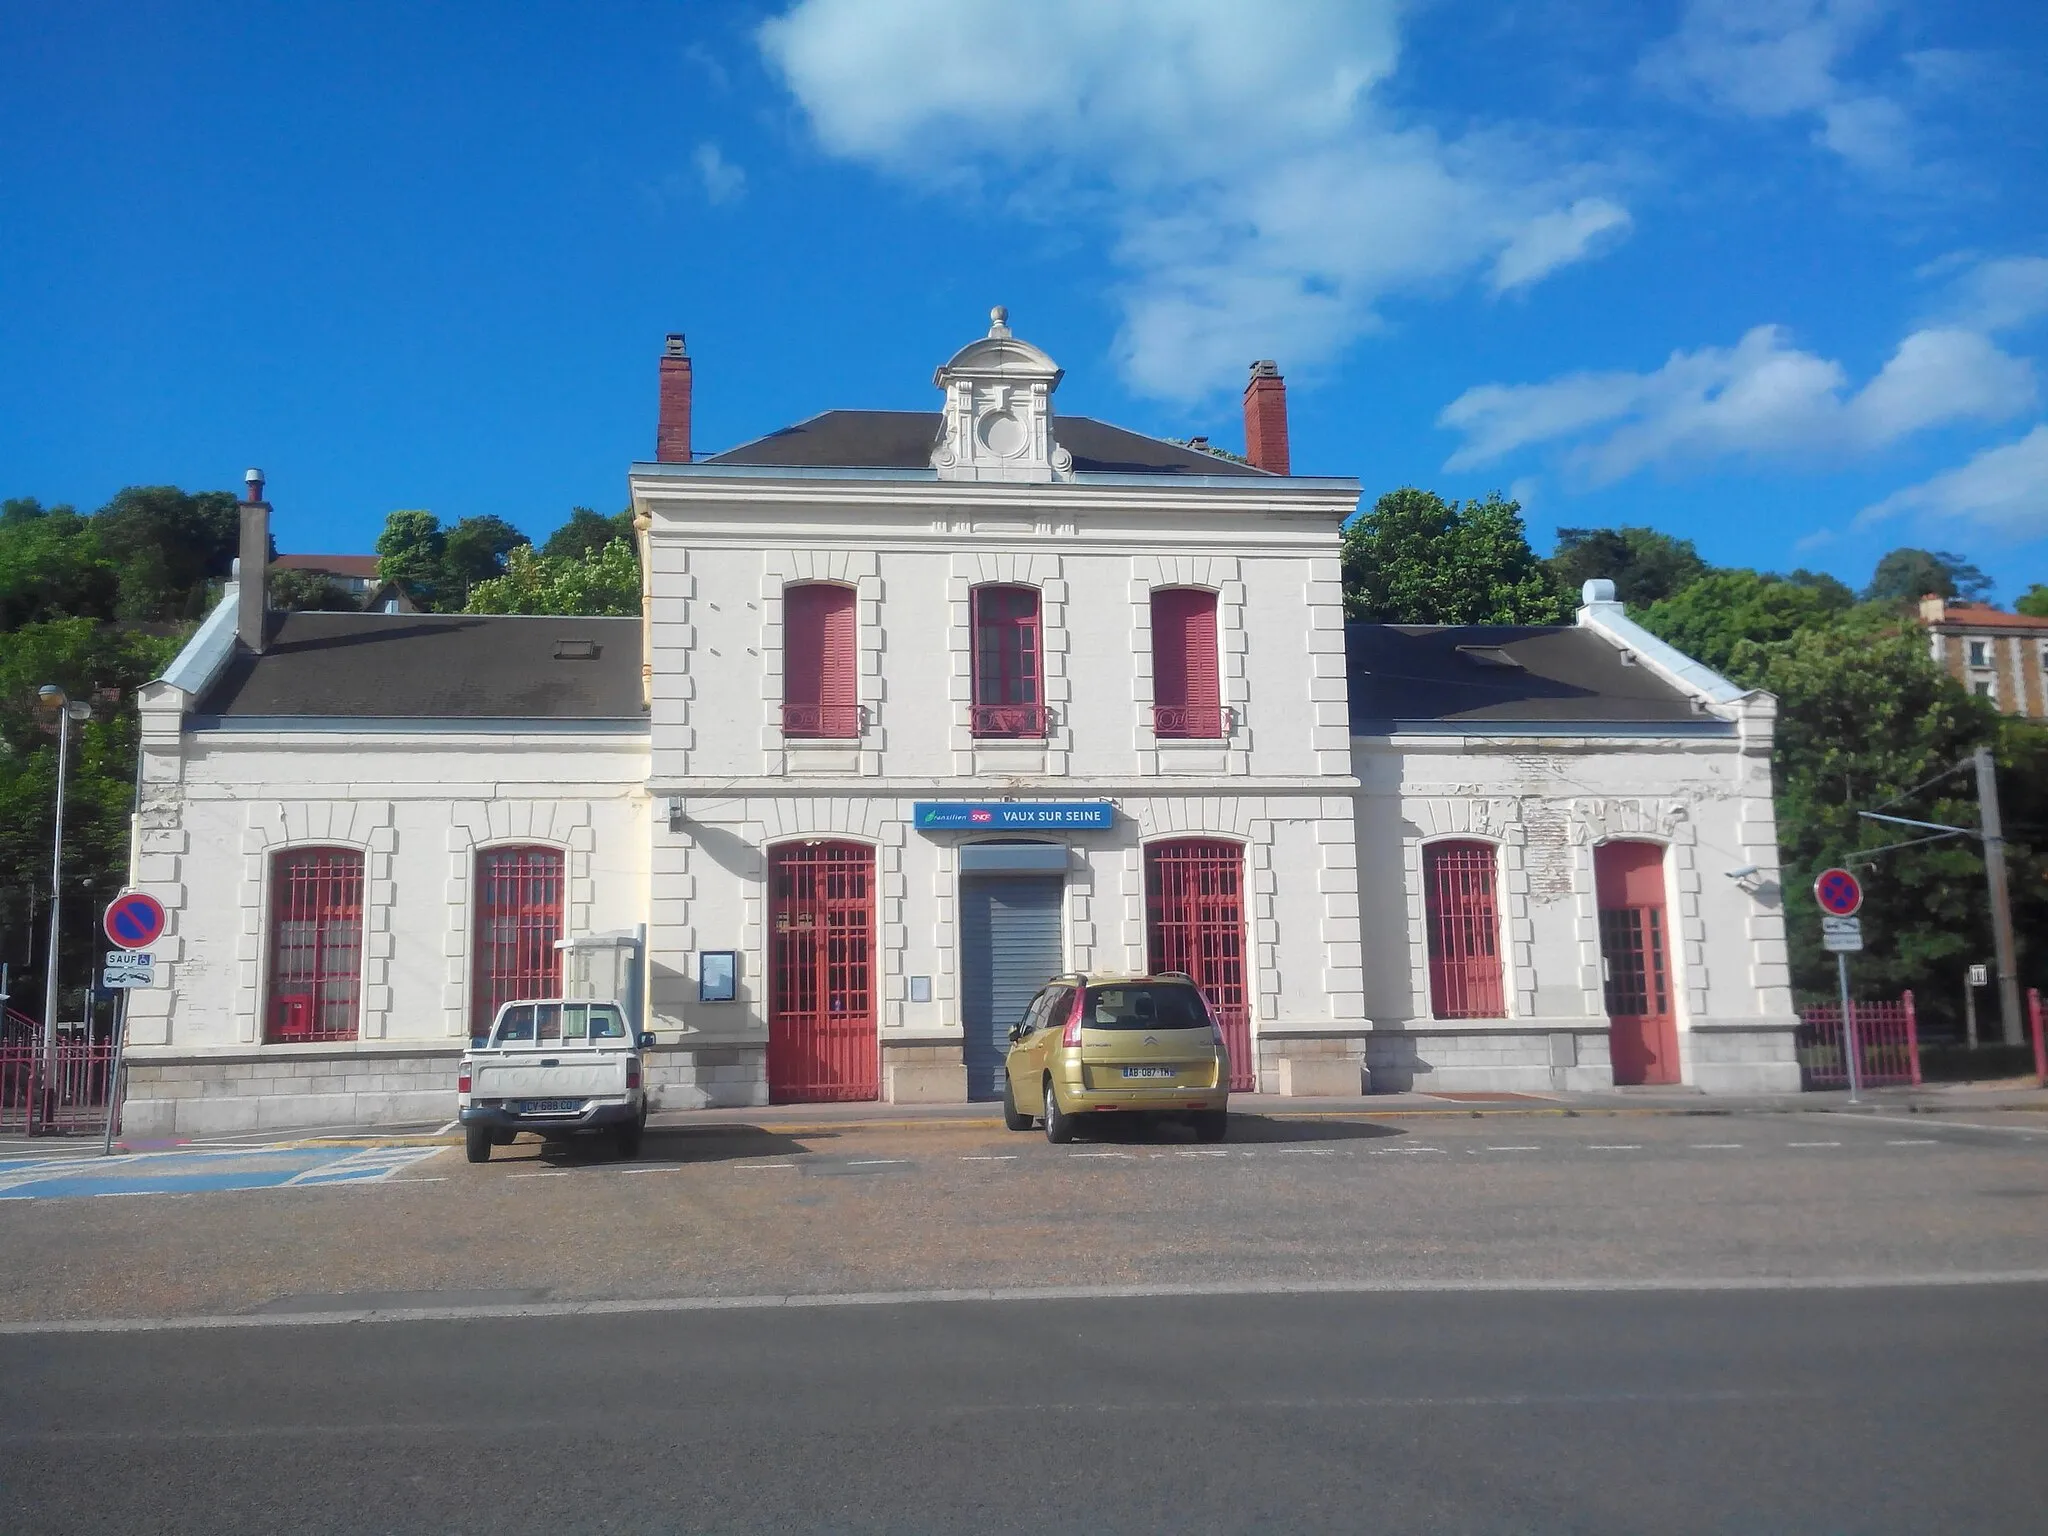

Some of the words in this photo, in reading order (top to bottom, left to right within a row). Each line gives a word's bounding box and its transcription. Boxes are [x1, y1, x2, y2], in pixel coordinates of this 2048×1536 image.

[972, 813, 991, 821] SNCF
[1003, 811, 1035, 821] VAUX
[1038, 811, 1063, 821] SUR
[1065, 811, 1101, 821] SEINE
[109, 955, 137, 964] SAUF
[488, 1067, 608, 1089] TOYOTA
